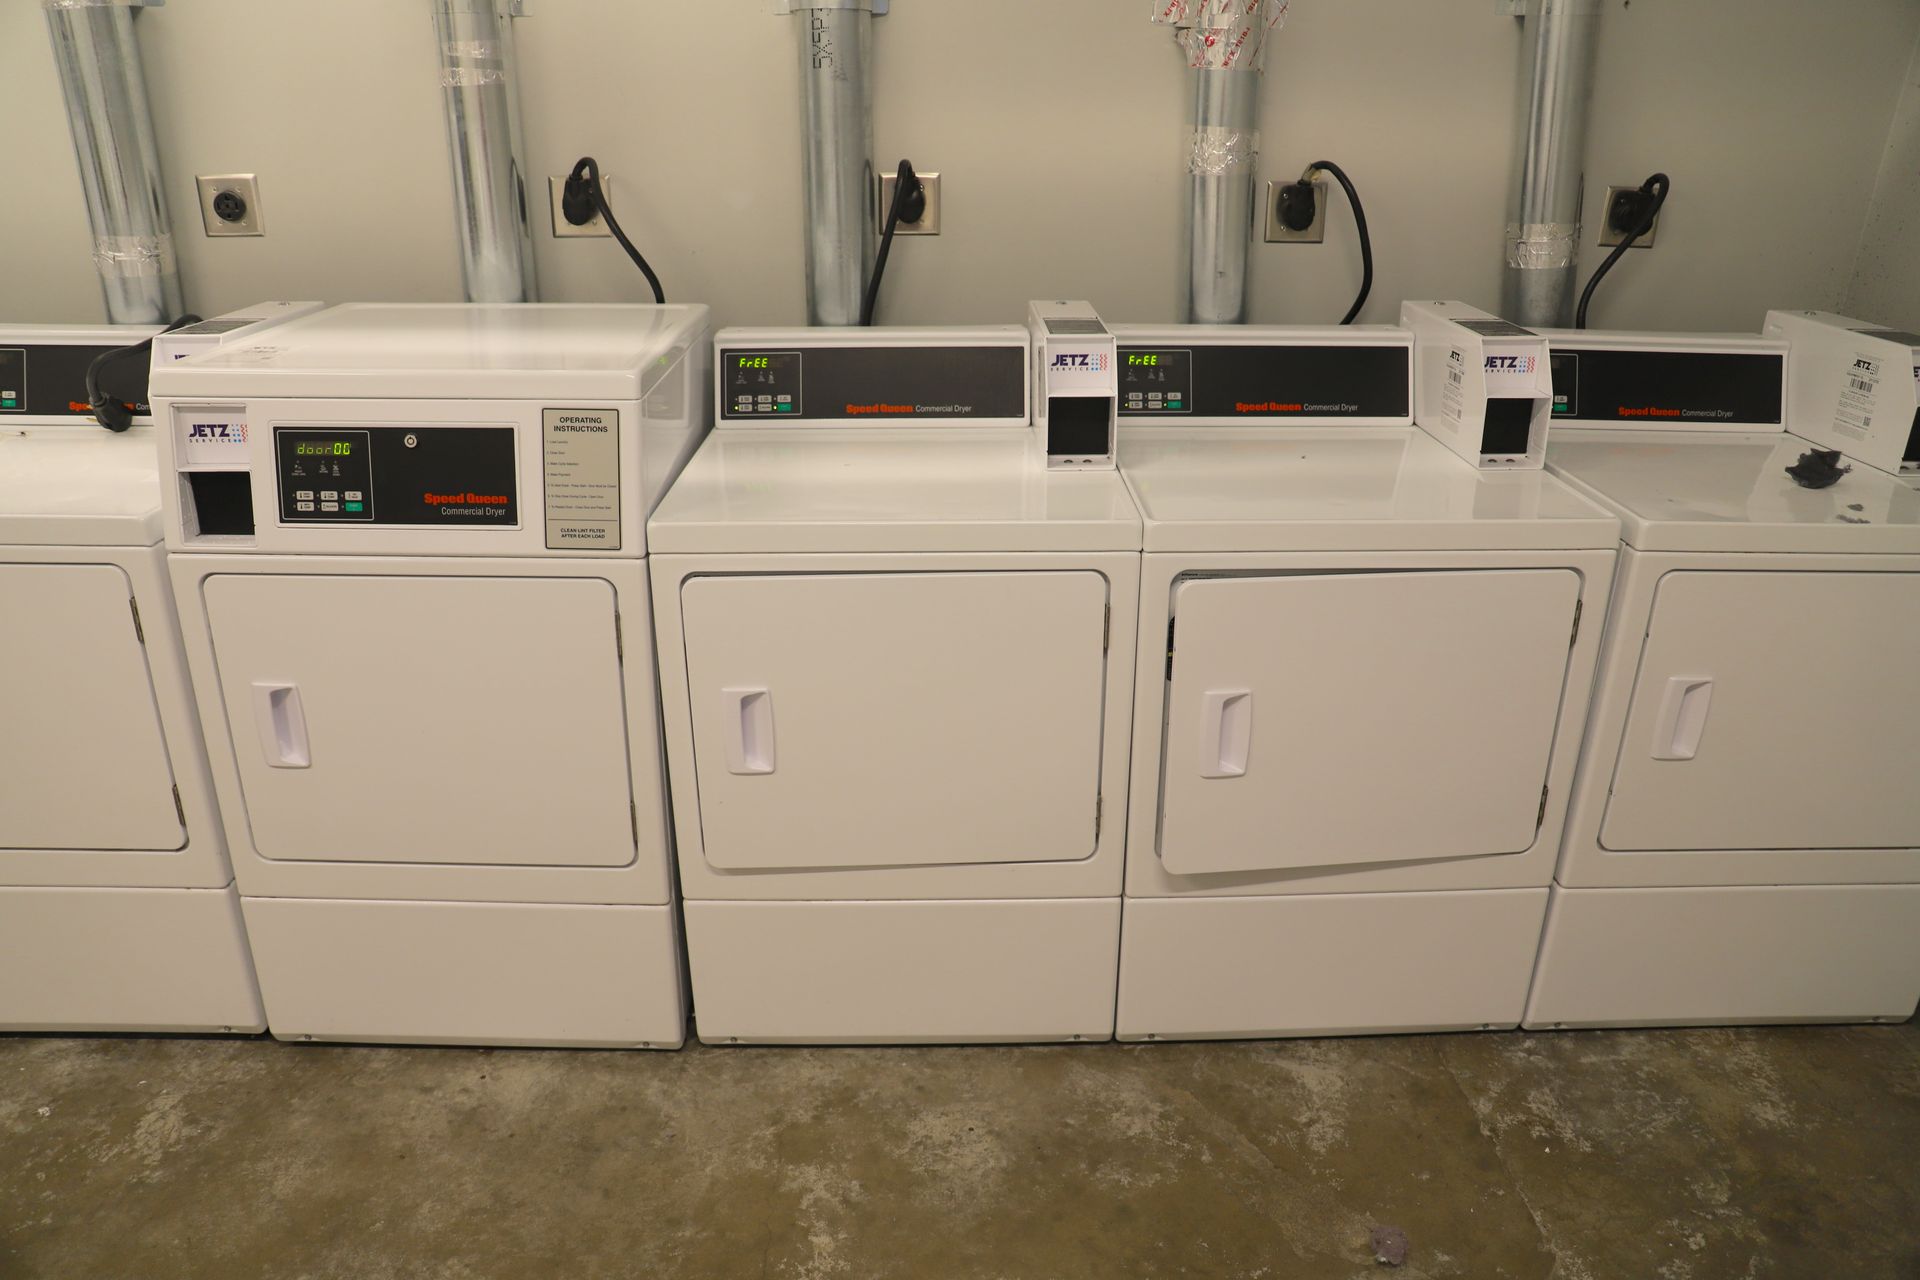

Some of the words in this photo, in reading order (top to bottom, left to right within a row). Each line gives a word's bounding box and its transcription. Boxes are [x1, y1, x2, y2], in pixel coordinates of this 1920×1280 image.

[1050, 354, 1090, 367] JETZ
[1484, 356, 1519, 369] JETZ
[846, 403, 879, 414] Speed
[880, 403, 914, 413] Queen
[915, 404, 953, 413] Commercial
[954, 405, 972, 414] Dryer
[1236, 402, 1268, 412] Speed
[1269, 401, 1302, 411] Queen
[1303, 403, 1340, 411] Commercial
[1341, 403, 1358, 412] Dryer
[1618, 406, 1649, 416] Speed
[1649, 407, 1680, 416] Queen
[1681, 408, 1717, 417] Commercial
[1717, 409, 1734, 418] Dryer
[559, 416, 602, 424] OPERATING
[189, 424, 231, 437] JETZ
[553, 425, 608, 433] INSTRUCTIONS
[424, 492, 465, 505] Speed
[466, 492, 509, 504] Queen
[441, 506, 484, 516] Commercial
[485, 507, 506, 517] Dryer
